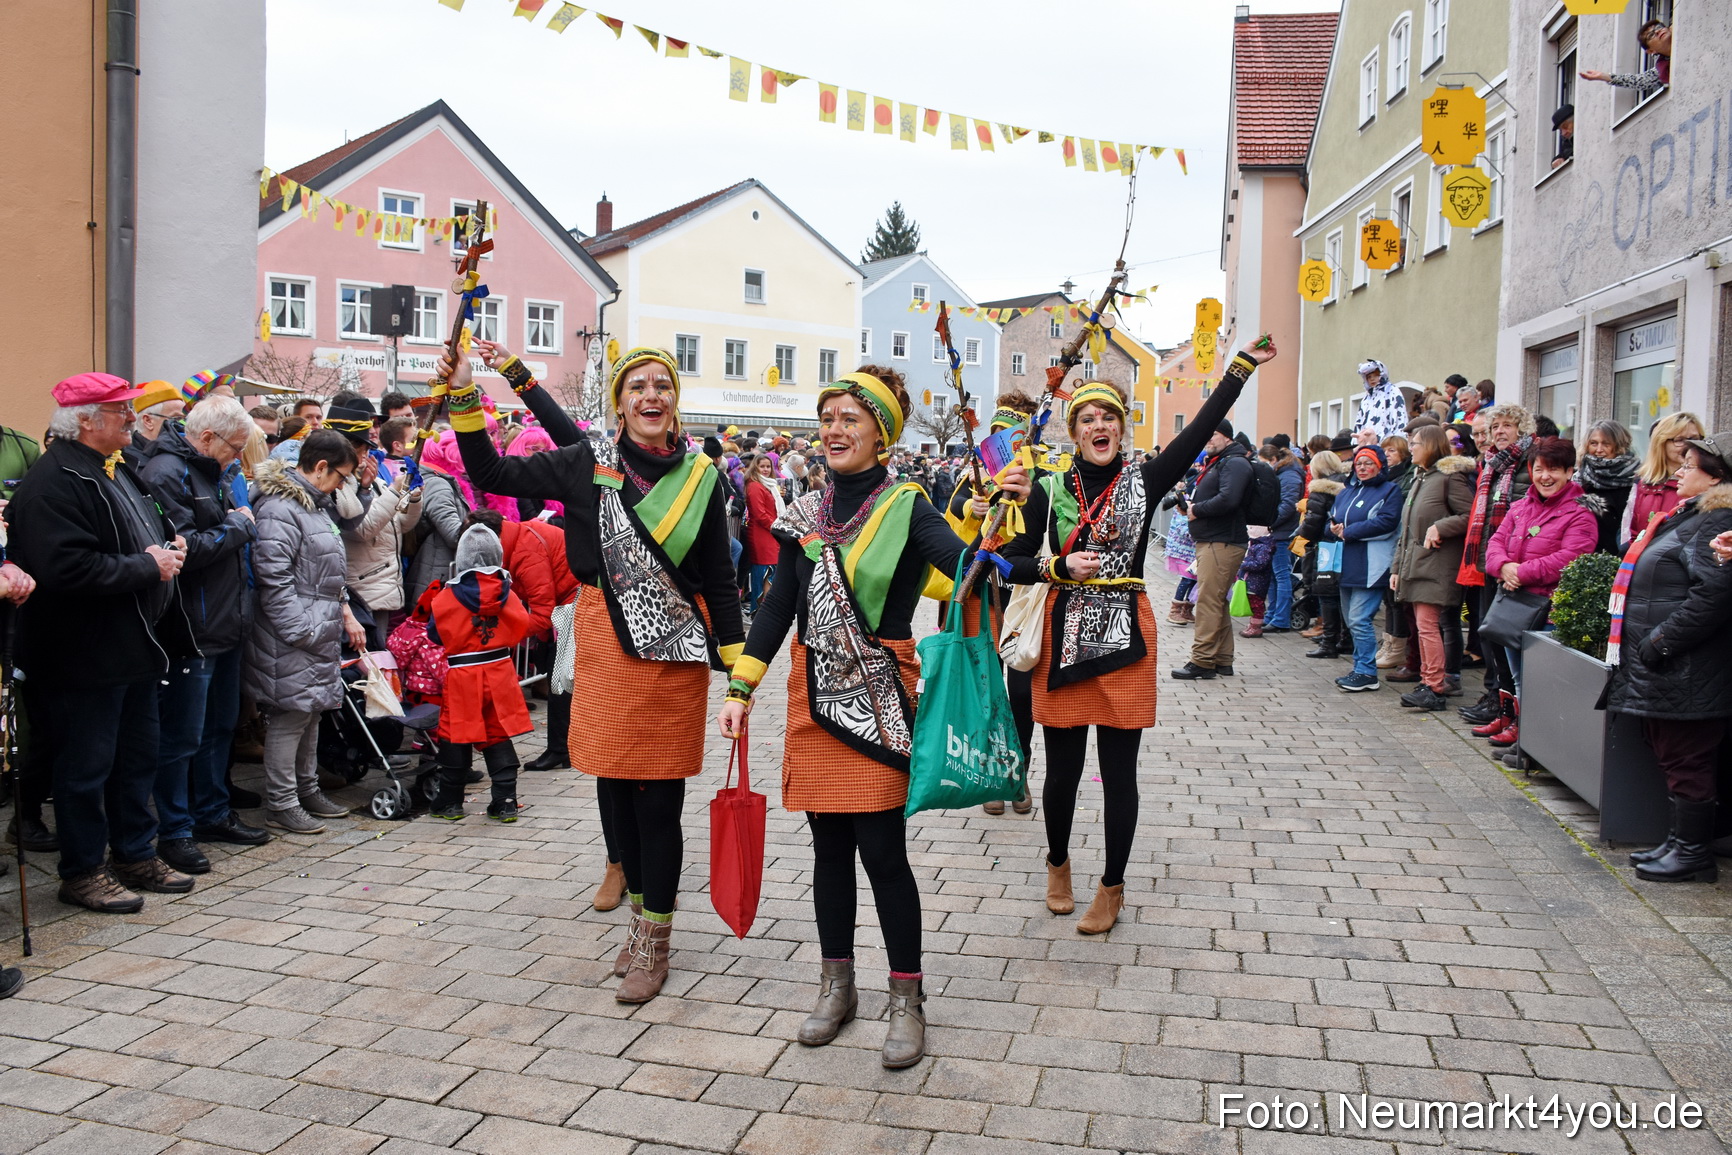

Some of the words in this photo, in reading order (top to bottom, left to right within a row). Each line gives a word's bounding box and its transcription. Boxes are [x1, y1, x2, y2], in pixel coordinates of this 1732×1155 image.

[341, 354, 385, 369] asthof
[409, 357, 435, 370] Post
[722, 391, 764, 404] Schuhmoden
[766, 394, 799, 407] Döllinger
